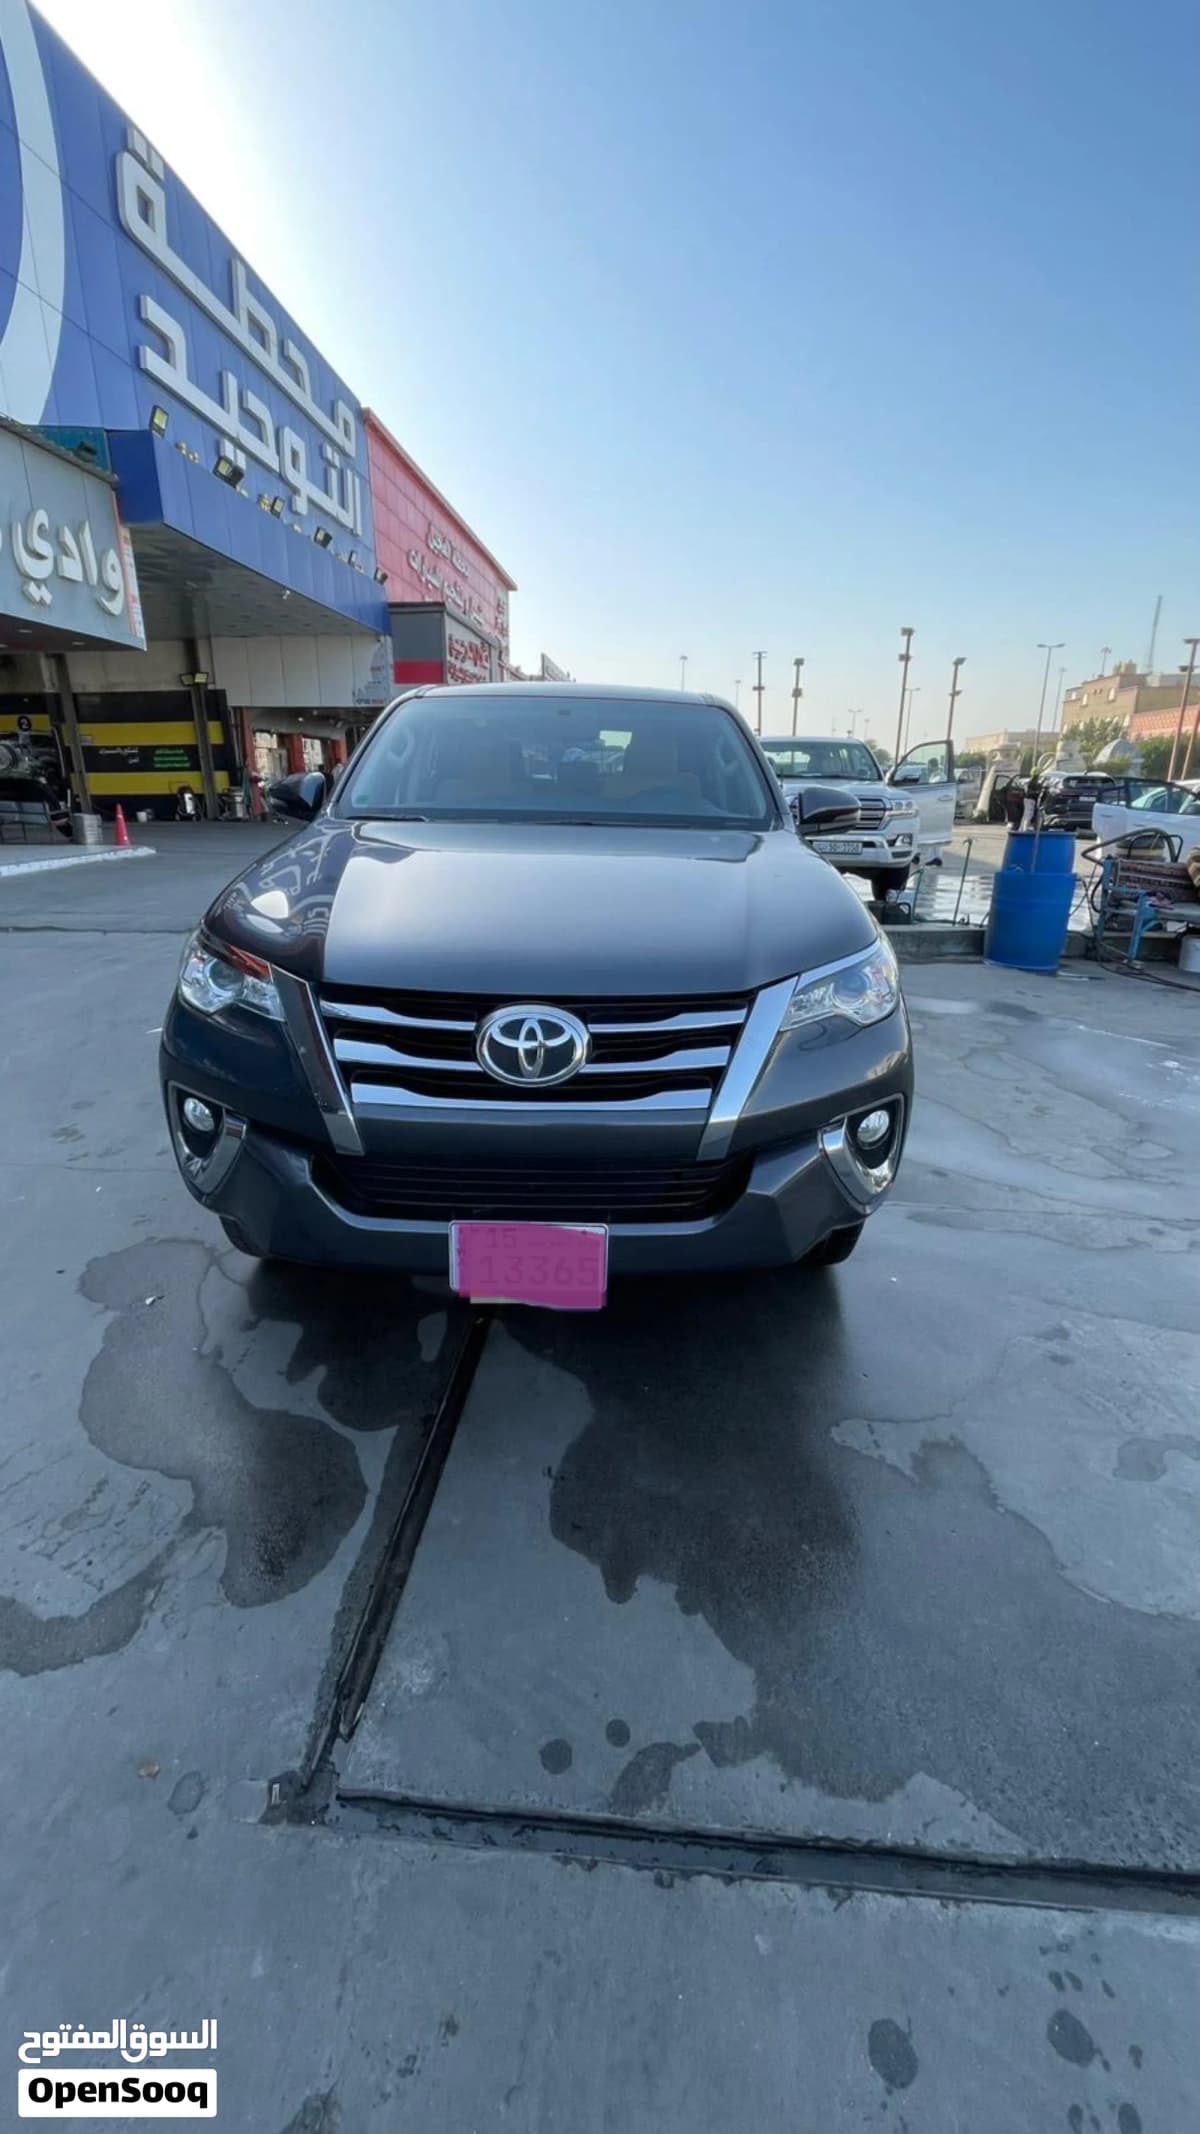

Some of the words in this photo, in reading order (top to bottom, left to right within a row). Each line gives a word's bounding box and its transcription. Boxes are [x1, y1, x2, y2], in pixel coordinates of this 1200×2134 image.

[115, 127, 355, 459] محطة
[138, 294, 362, 537] التوحيد
[12, 508, 125, 616] وادي
[479, 1256, 599, 1286] 13365
